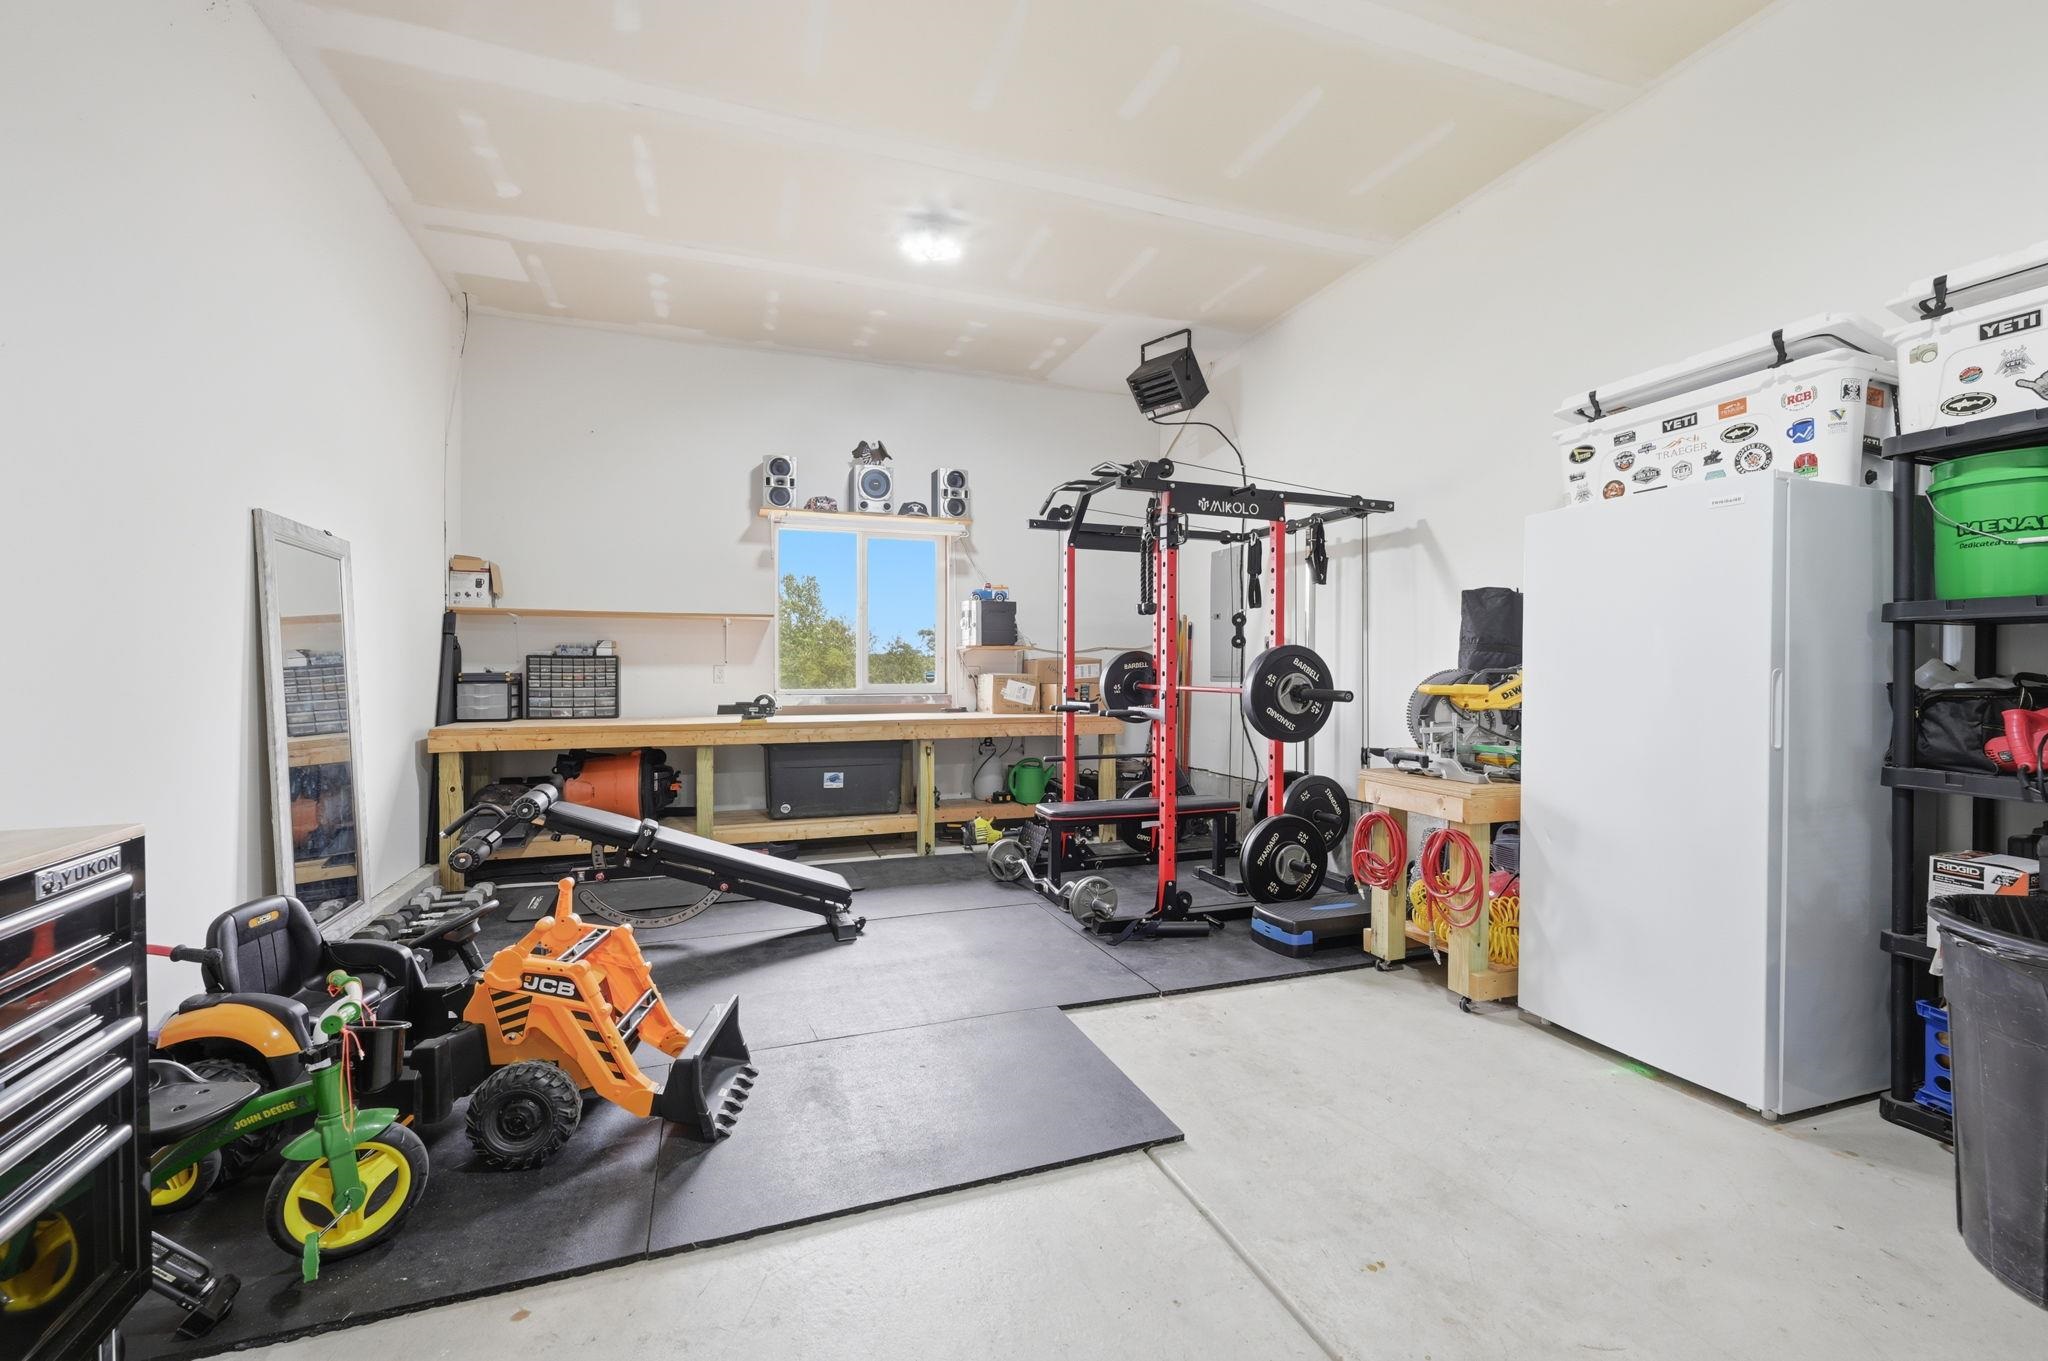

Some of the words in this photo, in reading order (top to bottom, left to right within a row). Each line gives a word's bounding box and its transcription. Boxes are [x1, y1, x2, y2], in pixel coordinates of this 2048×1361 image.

[1981, 312, 2038, 338] YETI
[1787, 390, 1812, 405] RCB
[1663, 414, 1696, 431] YETI
[1656, 441, 1708, 460] TRAEGER
[1209, 500, 1260, 515] MIKOLO
[1266, 673, 1277, 683] 45
[1292, 657, 1320, 682] BARBELL
[1266, 707, 1296, 731] STANDARD
[1310, 705, 1320, 715] 45
[1257, 832, 1280, 866] STANDARD
[61, 854, 118, 885] YUKON
[1936, 861, 1980, 876] RIDGID
[1267, 881, 1277, 893] 25
[523, 976, 576, 997] JCB
[233, 1112, 262, 1130] JOHN
[262, 1100, 297, 1119] DEERE
